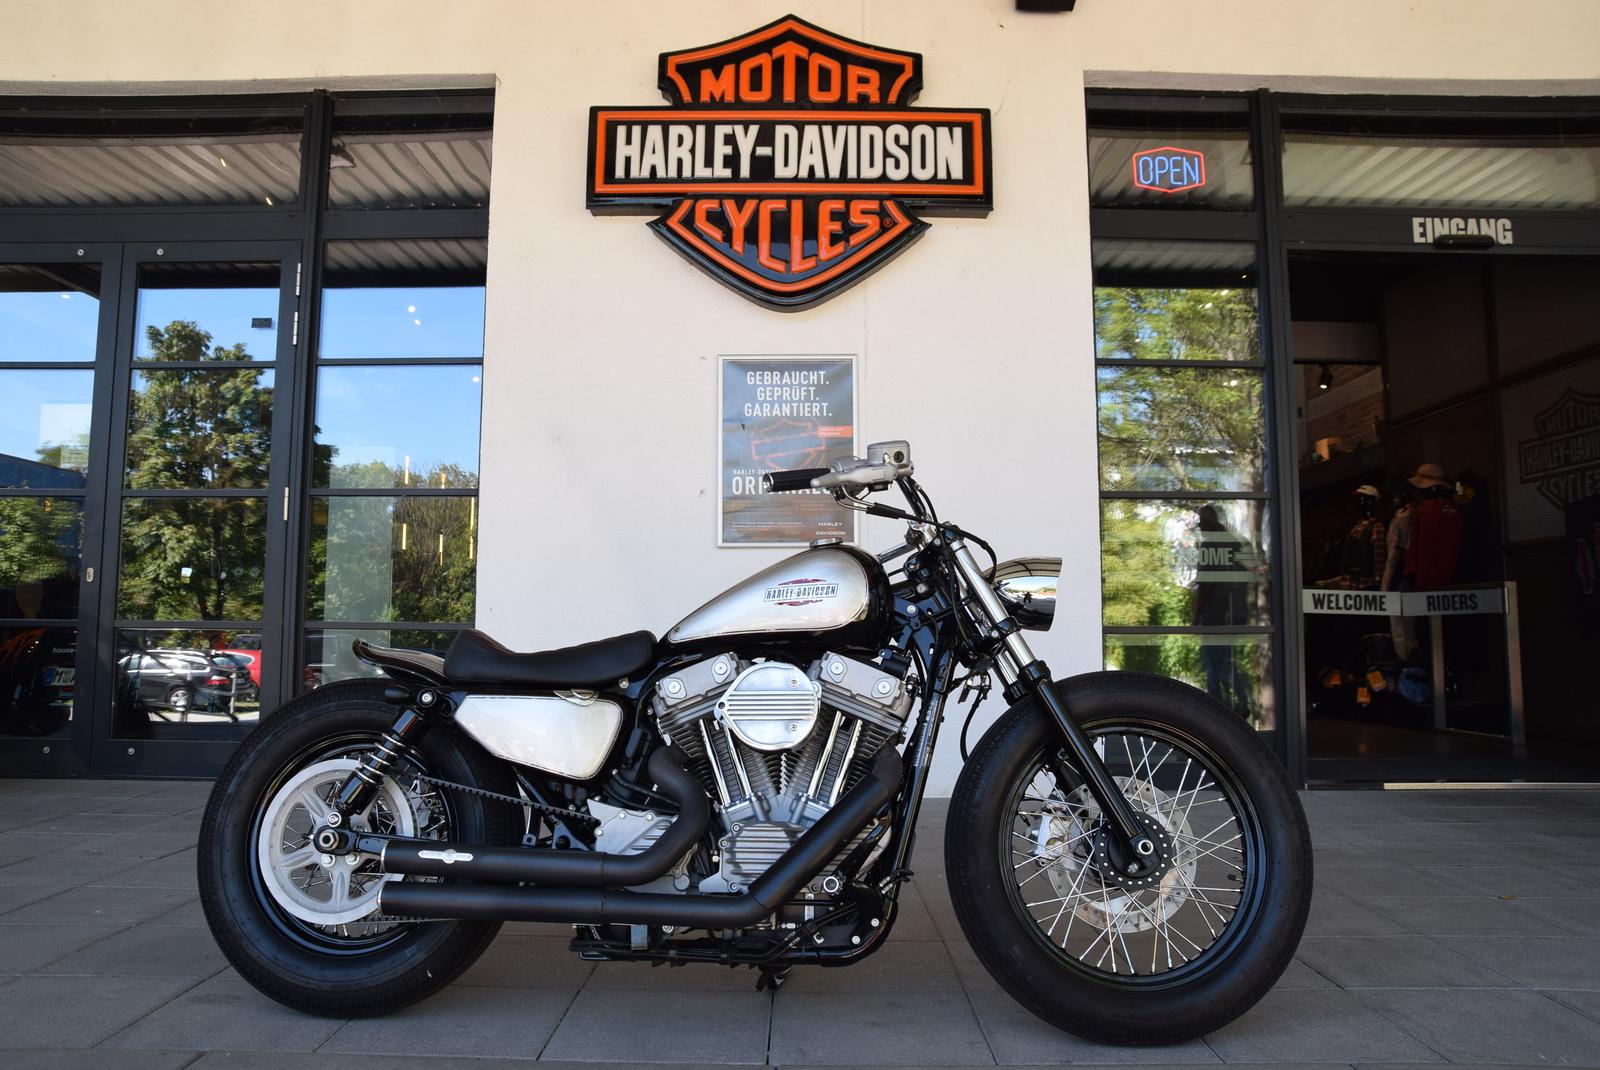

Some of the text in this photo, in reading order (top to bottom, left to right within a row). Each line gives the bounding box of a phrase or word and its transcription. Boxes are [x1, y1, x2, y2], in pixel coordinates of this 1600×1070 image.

[700, 40, 881, 104] MOTOR
[614, 123, 964, 182] HARLEY-DAVIDSON
[1138, 155, 1200, 186] OPEN
[694, 199, 881, 274] CYCLES
[1412, 216, 1514, 245] EINGANG
[746, 371, 830, 385] GEBRAUCHT.
[757, 386, 820, 401] GEPRÜFT.
[744, 402, 833, 417] GARANTIERT.
[766, 585, 836, 600] HARLEY-DAVIDSON
[1311, 592, 1388, 612] WELCOME
[1426, 593, 1479, 612] RIDERS
